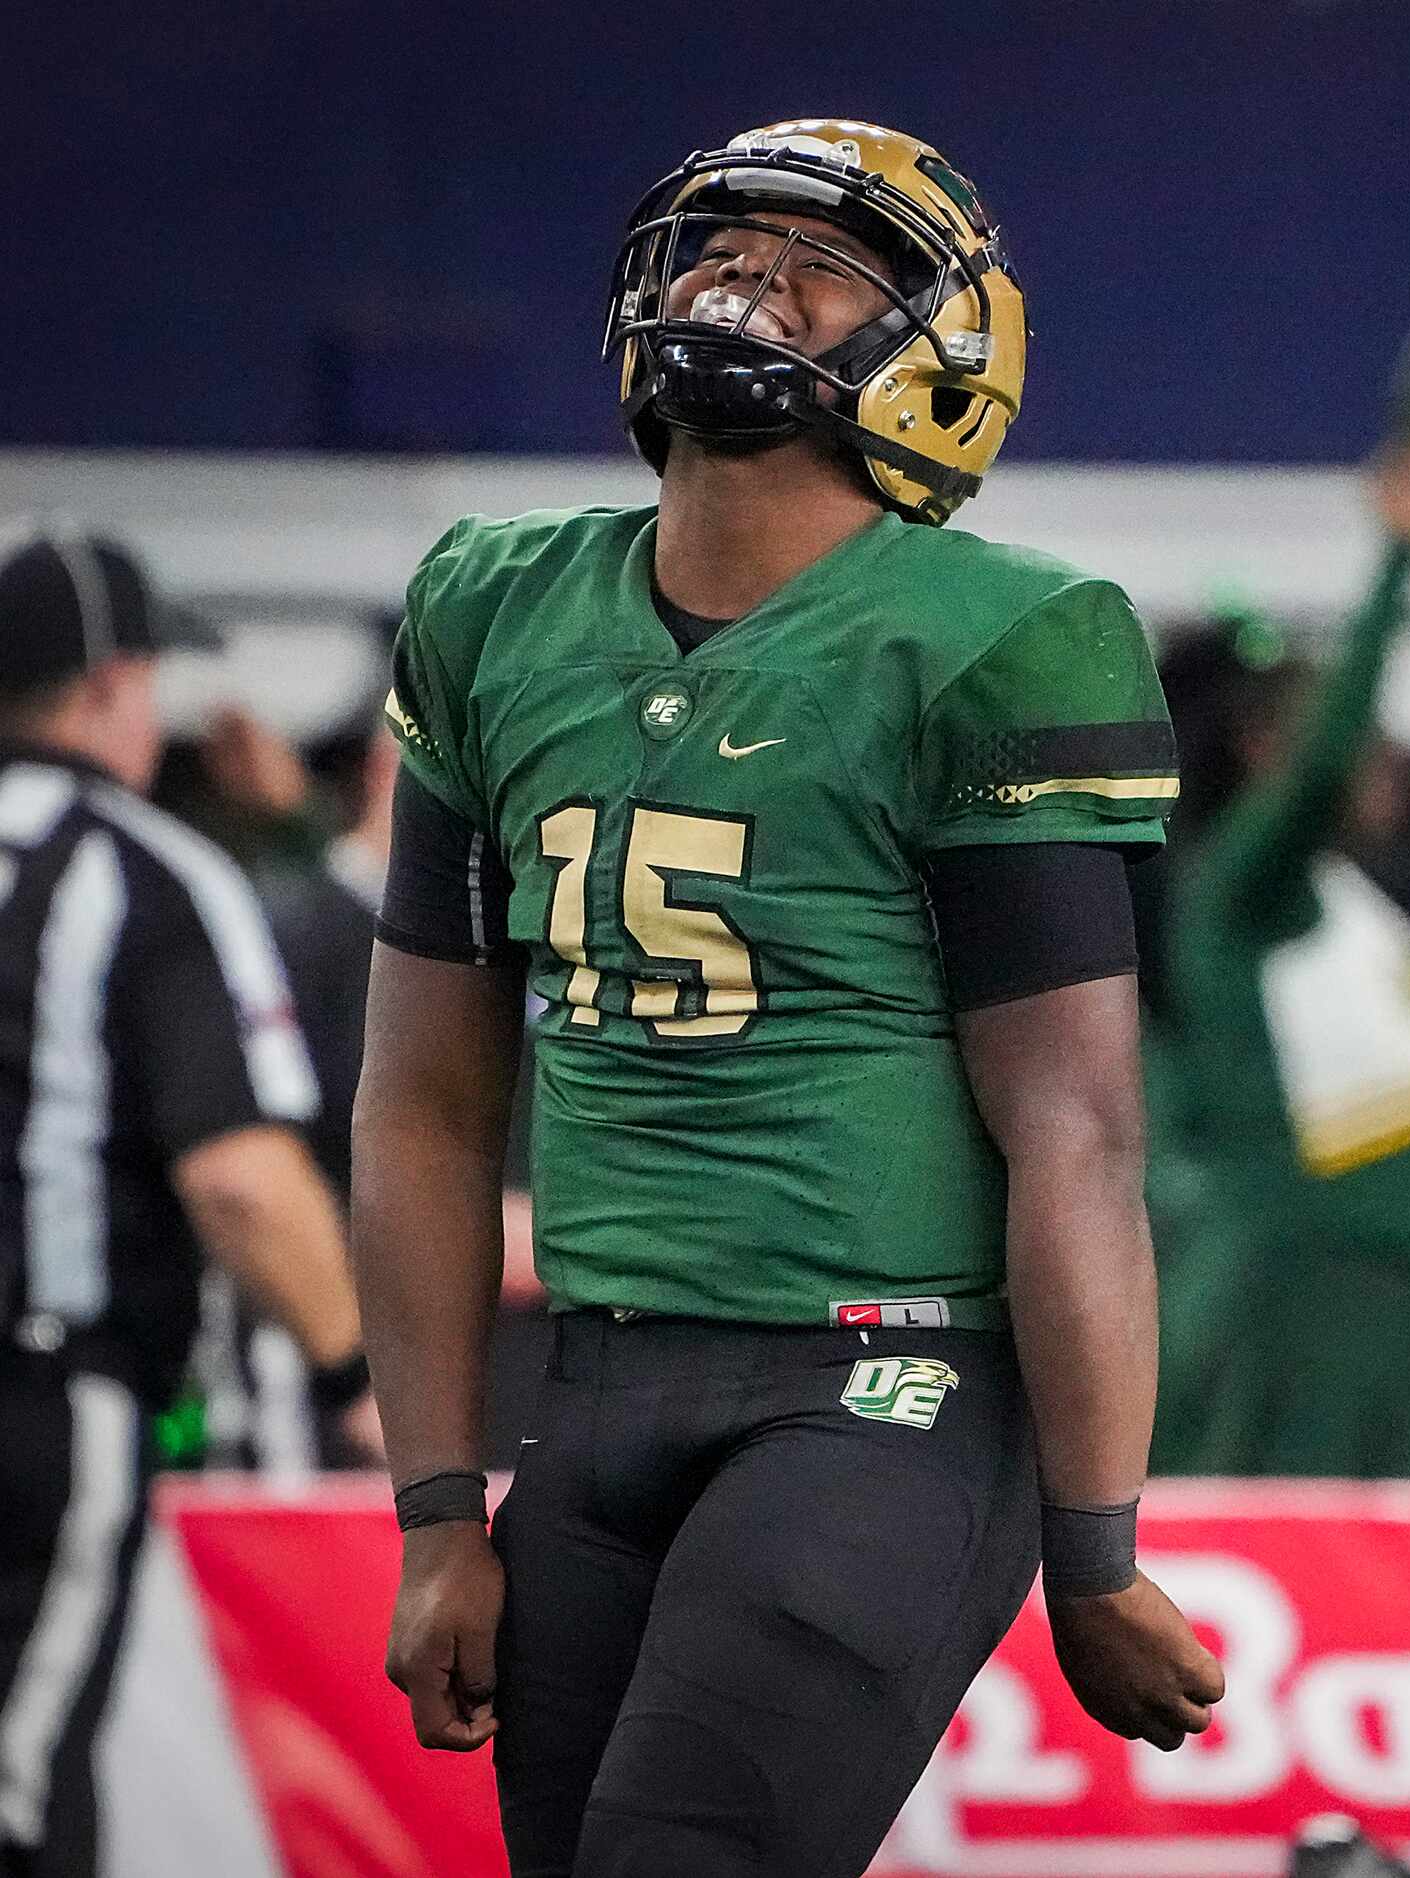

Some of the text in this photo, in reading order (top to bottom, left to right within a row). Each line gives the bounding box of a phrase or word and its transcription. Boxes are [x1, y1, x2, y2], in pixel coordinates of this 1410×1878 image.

[537, 803, 762, 1042] 15
[904, 1308, 919, 1325] L
[841, 1358, 949, 1430] DE
